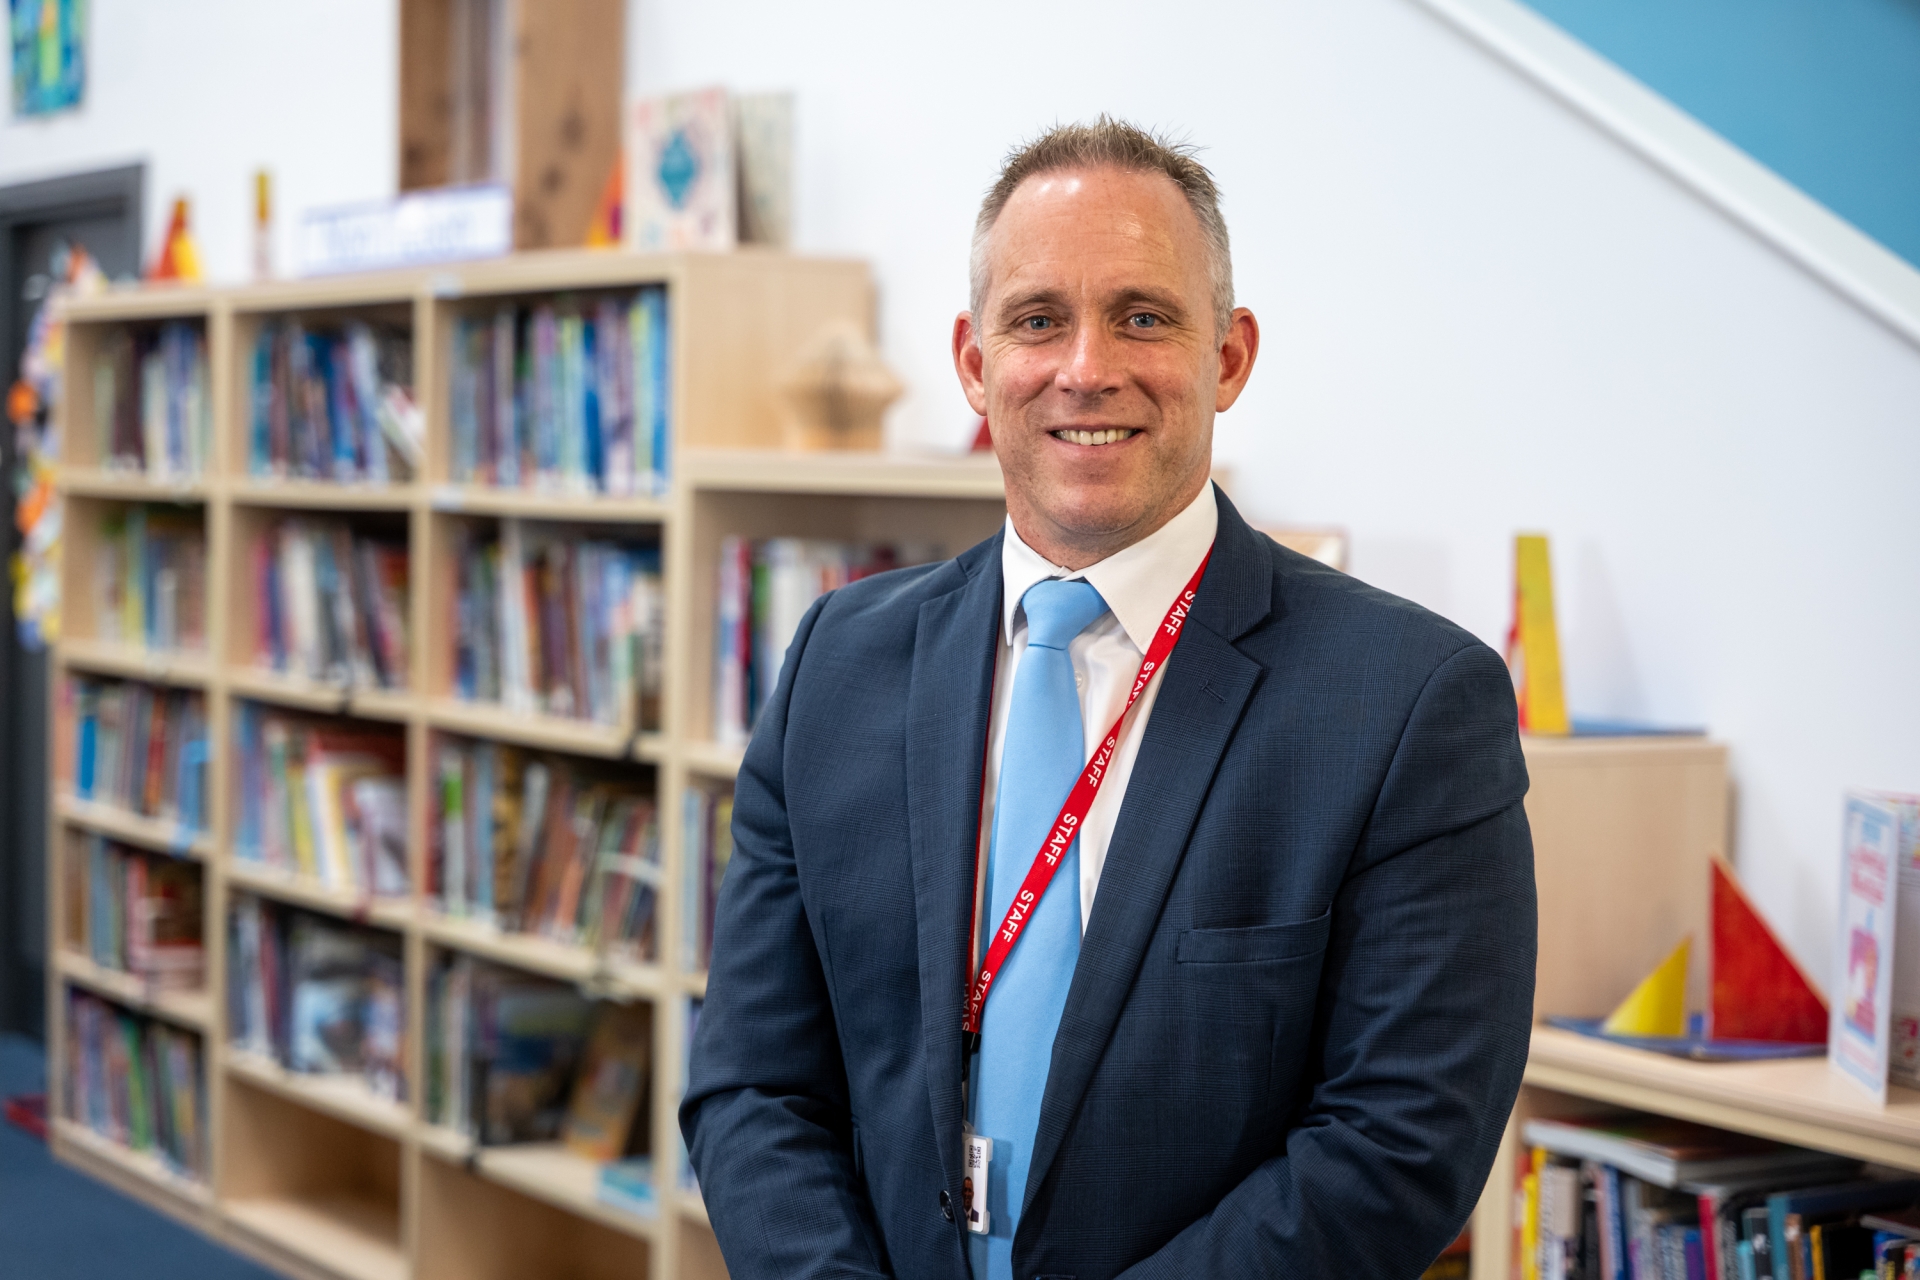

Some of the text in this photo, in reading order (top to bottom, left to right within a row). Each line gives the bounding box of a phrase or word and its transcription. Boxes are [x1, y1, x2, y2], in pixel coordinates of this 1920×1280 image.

[1164, 590, 1196, 636] STAFF
[1087, 736, 1116, 787] STAFF
[1044, 812, 1078, 866] STAFF
[1001, 889, 1035, 943] STAFF
